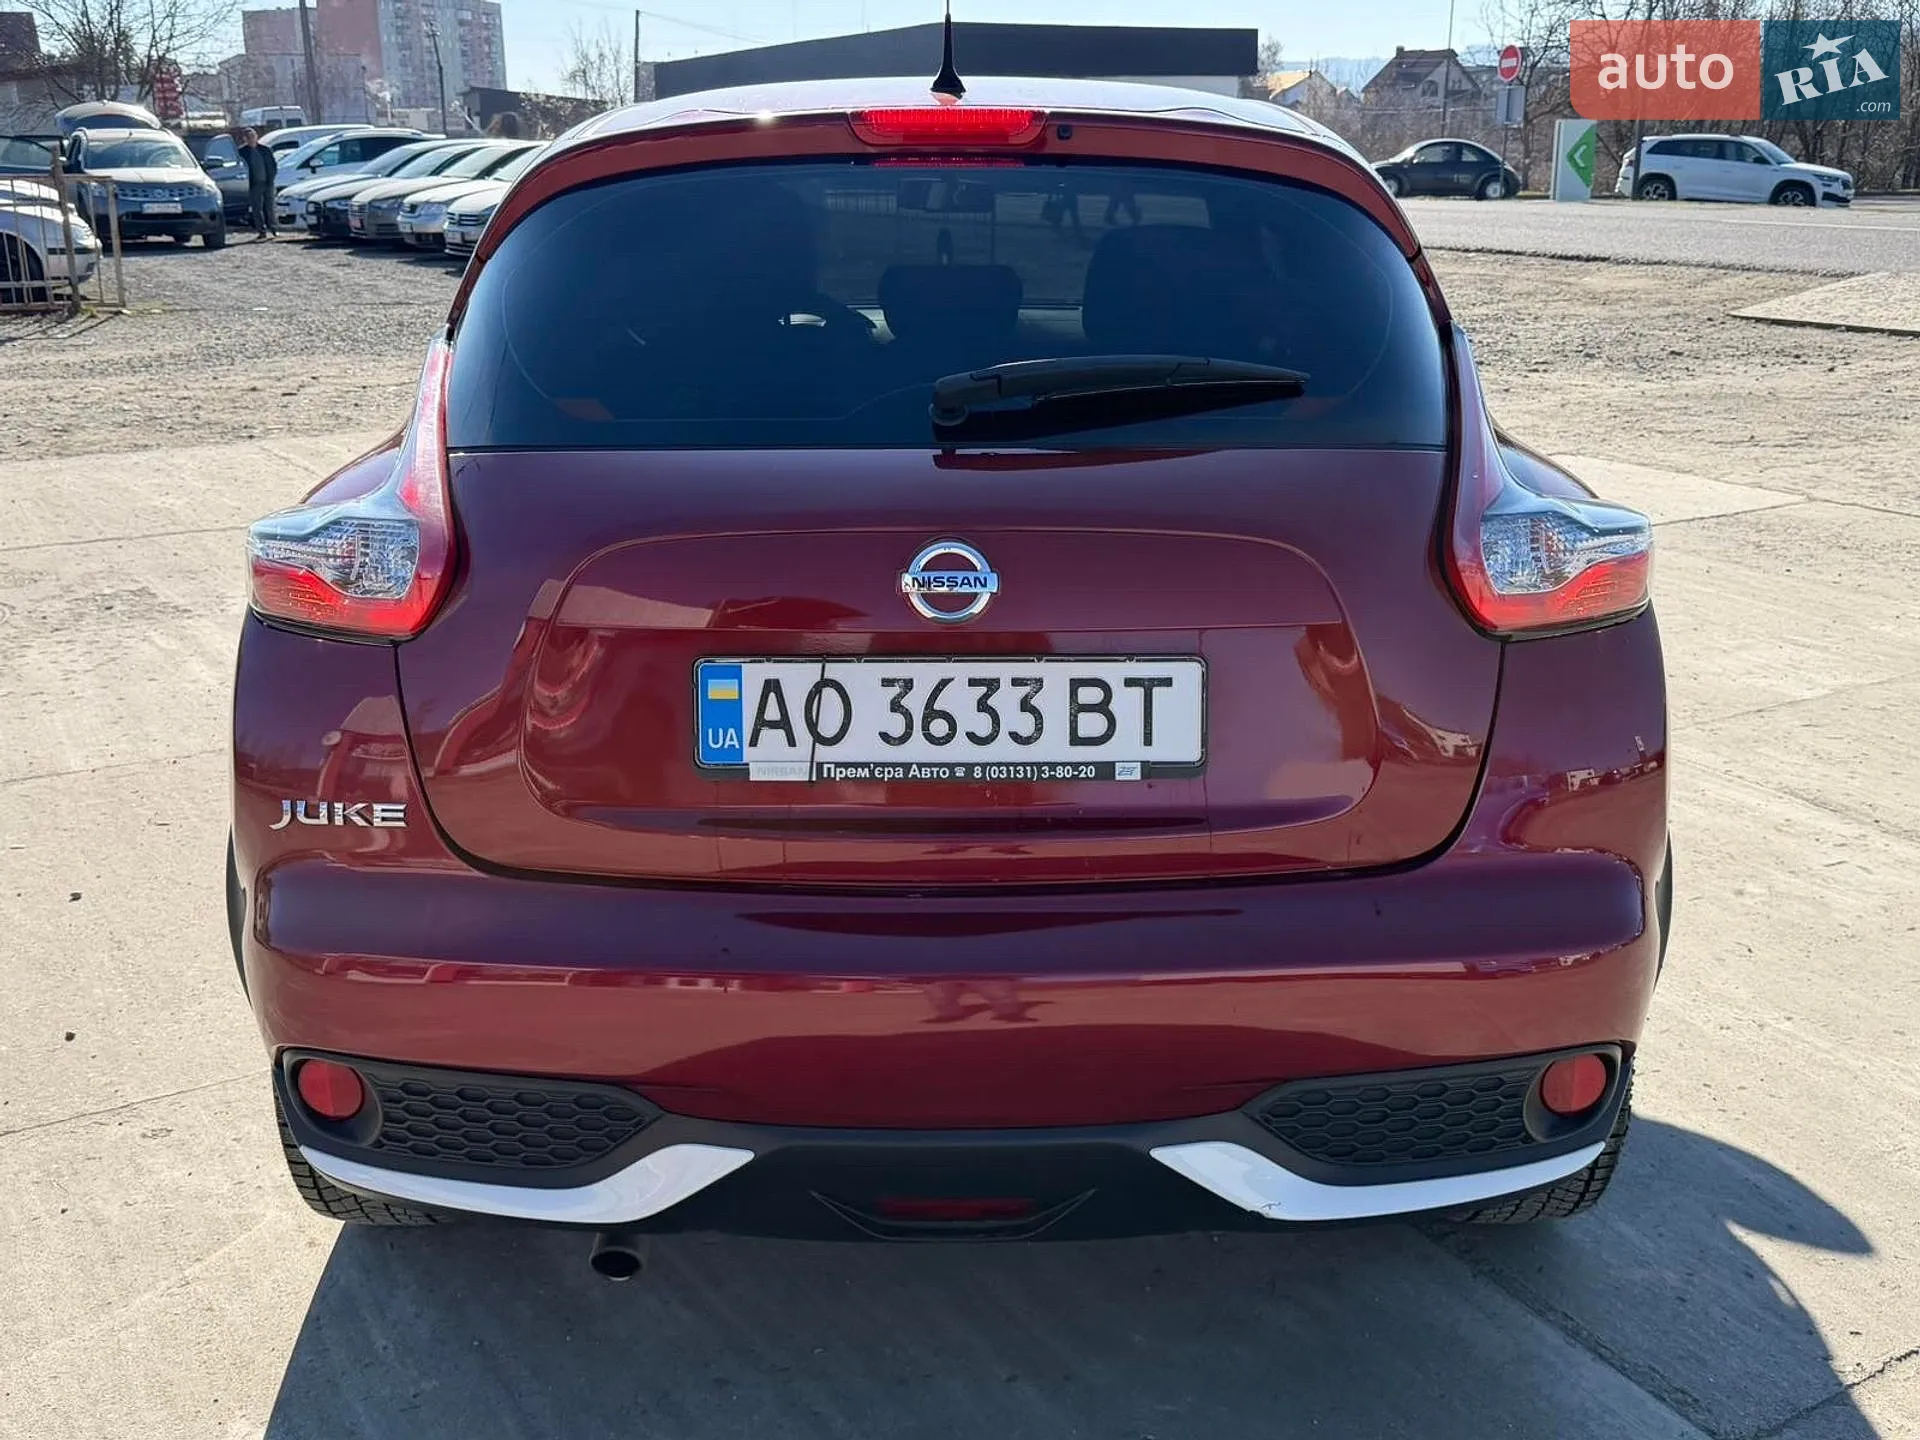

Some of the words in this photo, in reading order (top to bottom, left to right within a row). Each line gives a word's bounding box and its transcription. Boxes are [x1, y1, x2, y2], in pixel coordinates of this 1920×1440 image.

[911, 576, 988, 589] NISSAN
[749, 678, 852, 746] AO
[878, 677, 1044, 746] 3633
[1069, 677, 1173, 746] BT
[708, 727, 739, 748] UA
[822, 763, 904, 781] Прем'єра
[908, 764, 949, 778] Авто
[973, 766, 982, 778] 8
[986, 765, 1038, 780] (03131)
[1041, 765, 1096, 778] 3-80-20
[269, 800, 408, 830] JUKE
